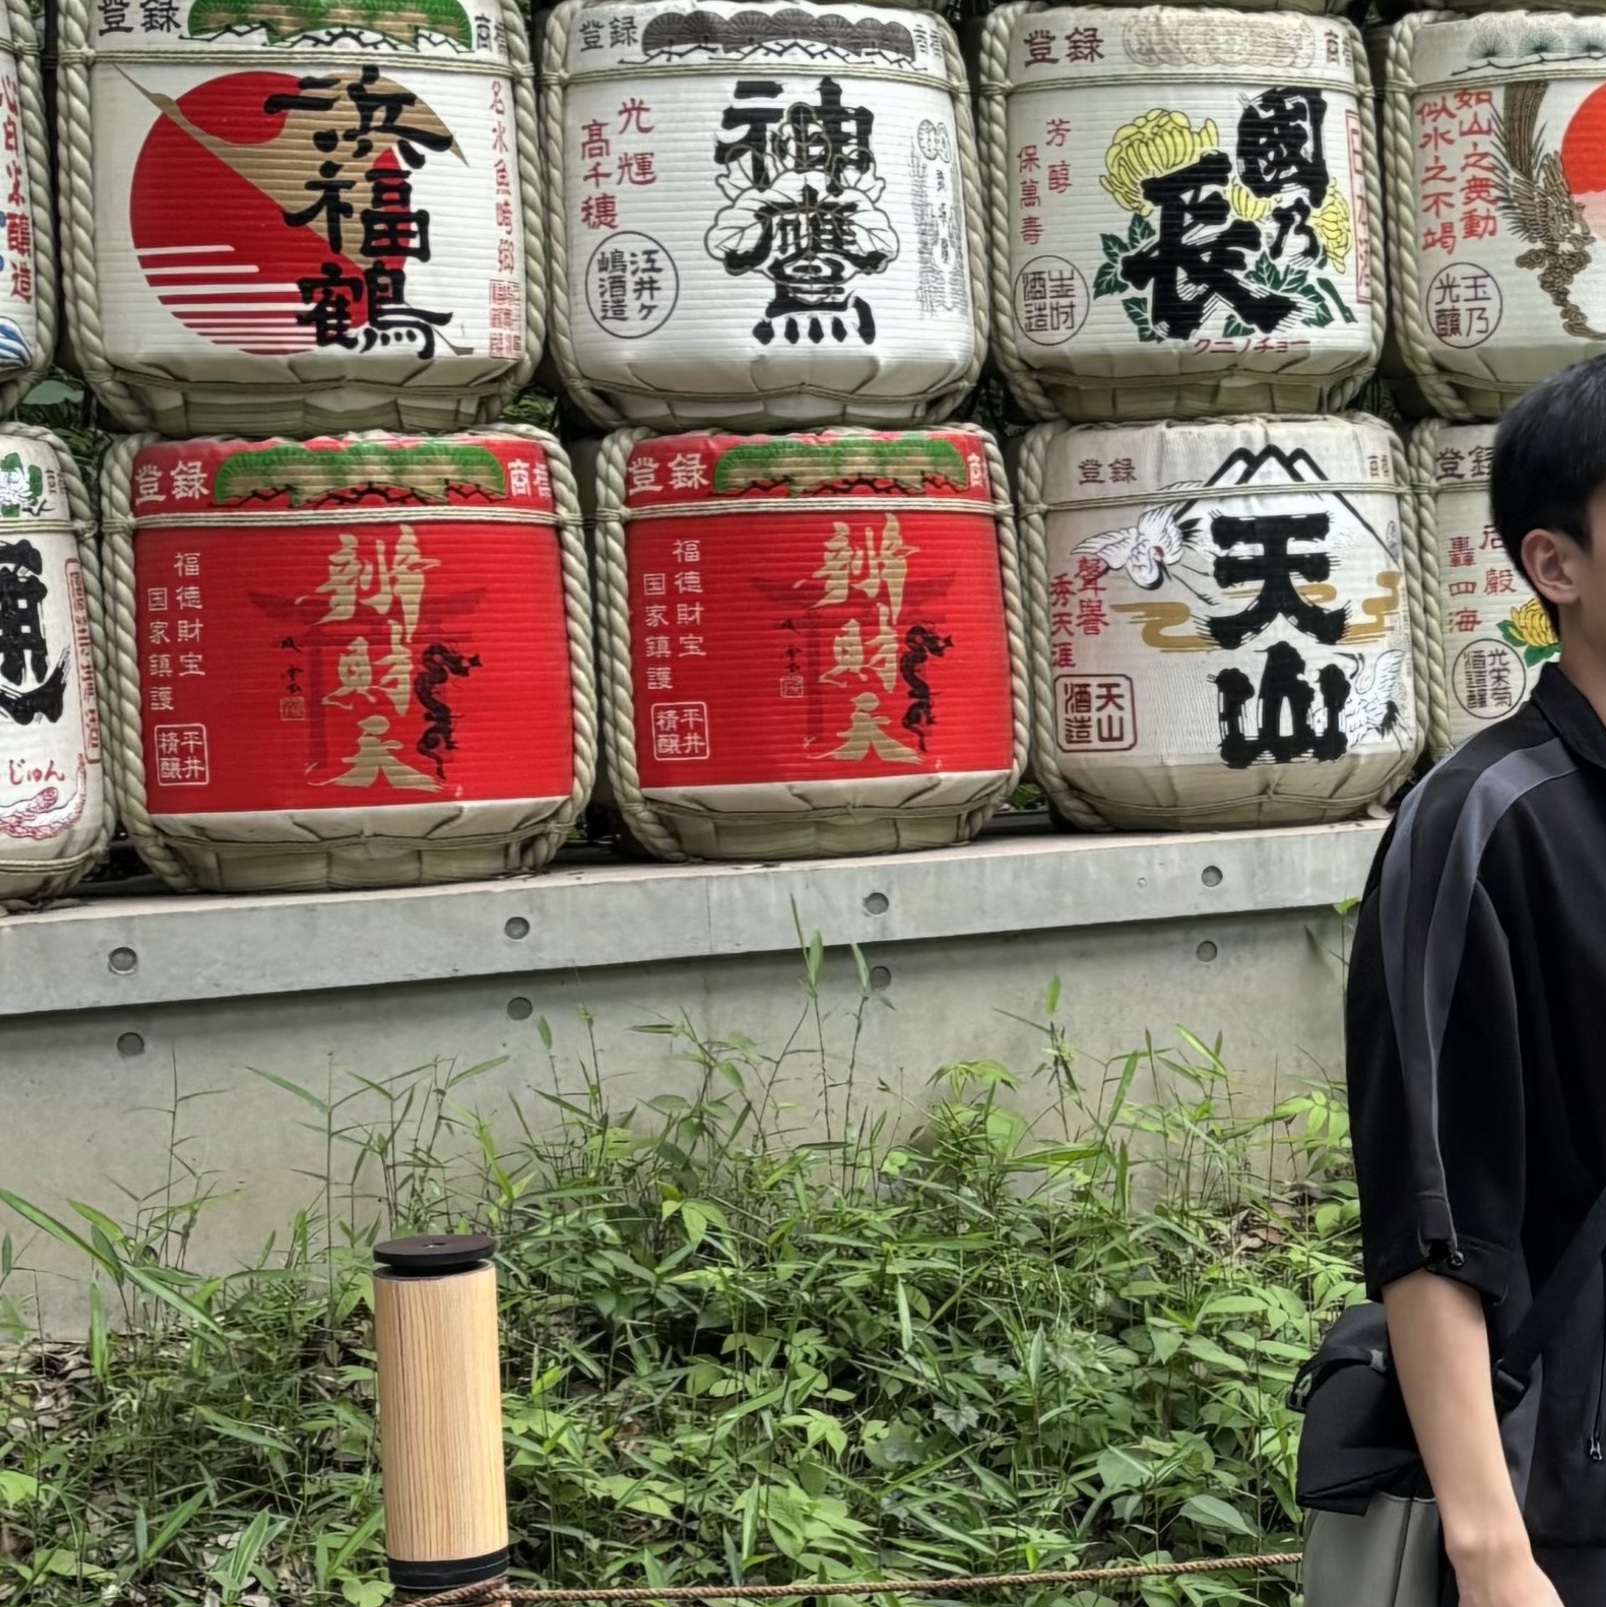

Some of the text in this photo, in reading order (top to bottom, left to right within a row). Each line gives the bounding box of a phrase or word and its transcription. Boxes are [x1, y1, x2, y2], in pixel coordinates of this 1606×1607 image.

[578, 16, 638, 52] 登録
[1024, 28, 1105, 68] 登録
[617, 97, 658, 187] 光輝
[1045, 118, 1072, 194] 芳醇
[134, 461, 209, 504] 登録
[628, 453, 709, 496] 登録
[1078, 458, 1138, 486] 登録
[147, 587, 174, 713] 国家鎮護
[644, 572, 674, 692] 国家鎮護
[1196, 511, 1353, 769] 天山
[680, 709, 706, 756] 平井
[1063, 682, 1094, 745] 酒造
[1095, 682, 1125, 743] 天山
[178, 730, 207, 780] 平井
